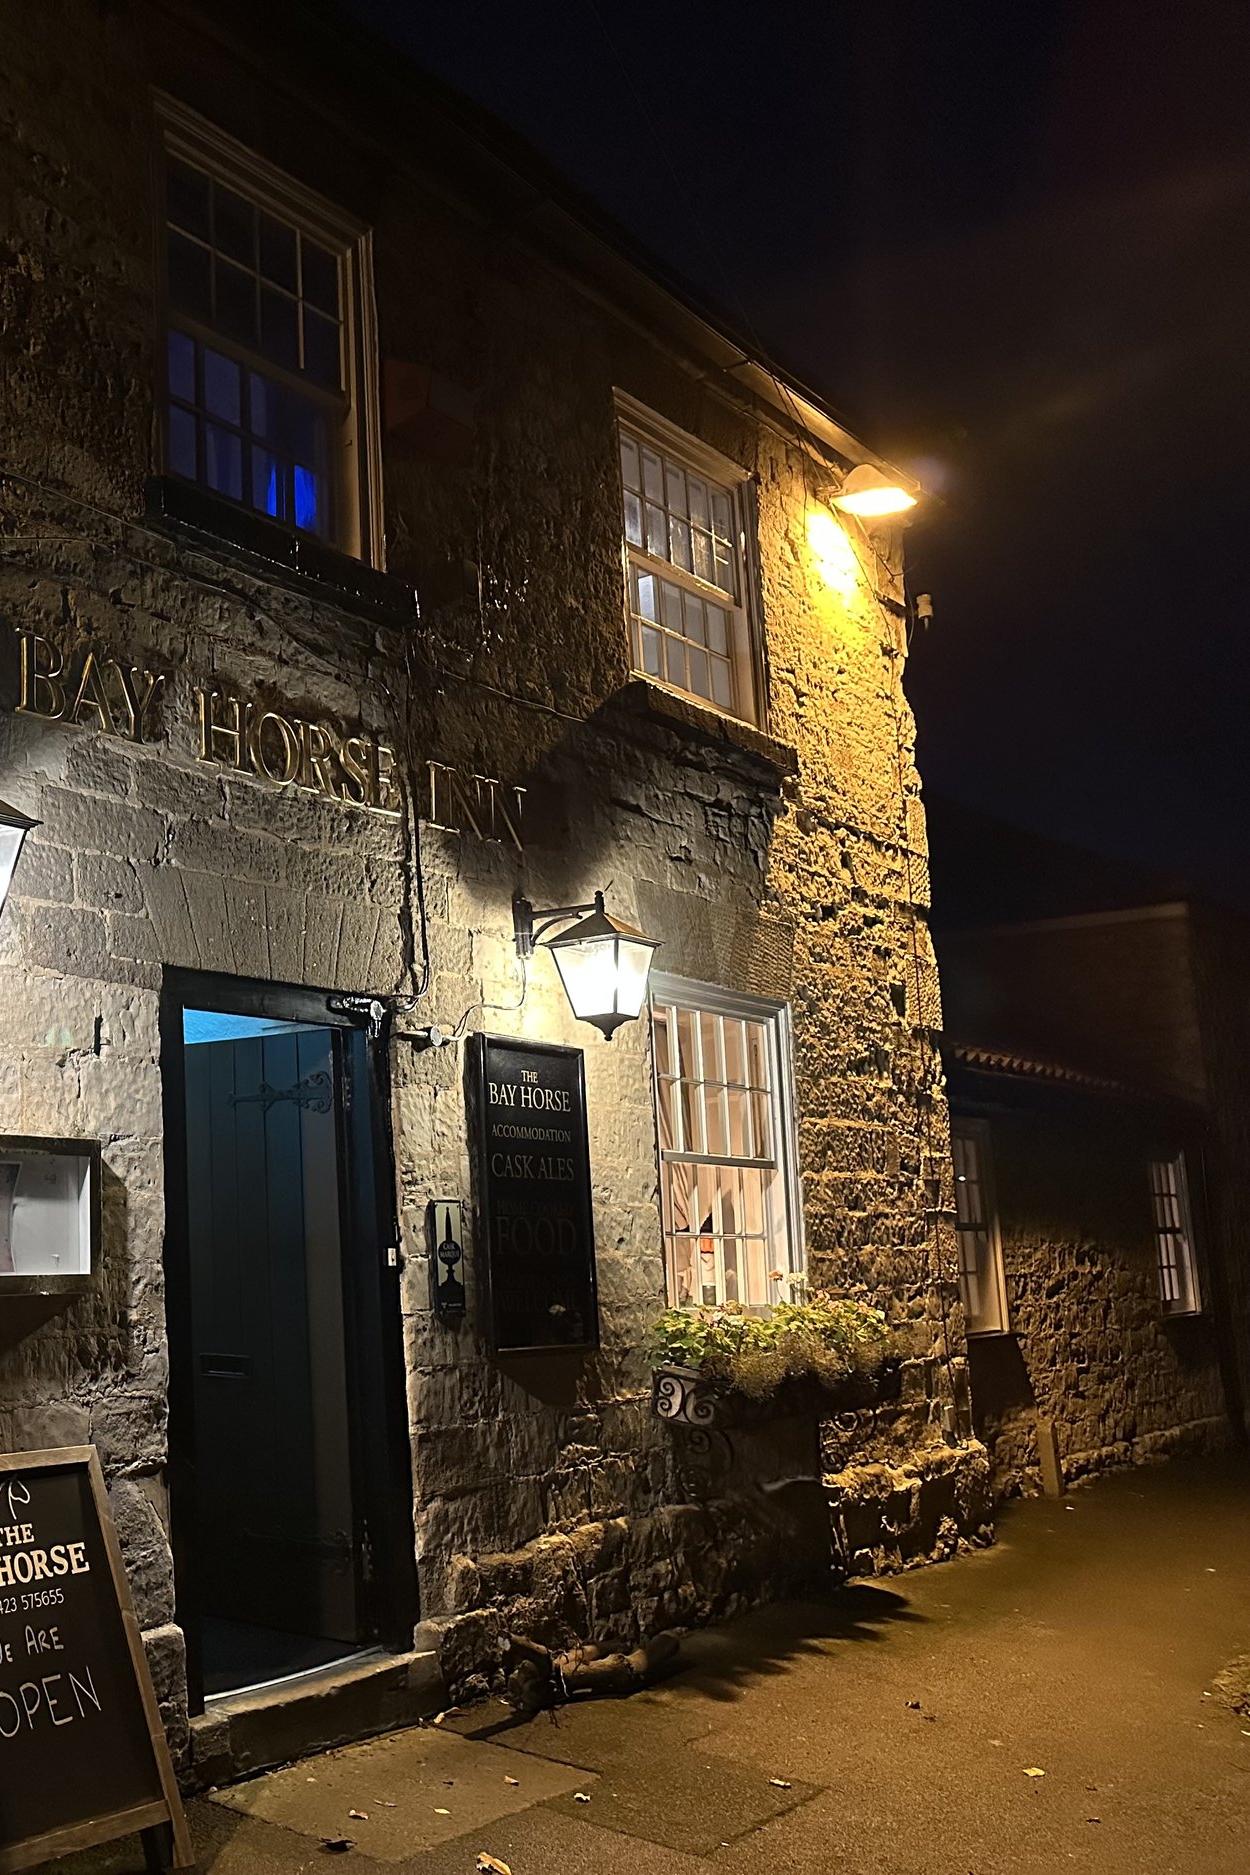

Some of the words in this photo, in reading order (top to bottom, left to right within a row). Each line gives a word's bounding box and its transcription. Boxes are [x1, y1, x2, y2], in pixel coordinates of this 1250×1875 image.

[14, 626, 166, 745] BAY
[193, 685, 402, 818] HORSE
[425, 760, 528, 852] INN
[520, 1069, 539, 1084] THE
[488, 1082, 518, 1106] BAY
[520, 1086, 571, 1112] HORSE
[491, 1123, 571, 1142] ACCOMMODATION
[491, 1153, 534, 1179] CASK
[536, 1157, 575, 1181] ALES
[495, 1216, 578, 1256] FOOD
[21, 1588, 65, 1611] 575655
[24, 1624, 65, 1656] ARE
